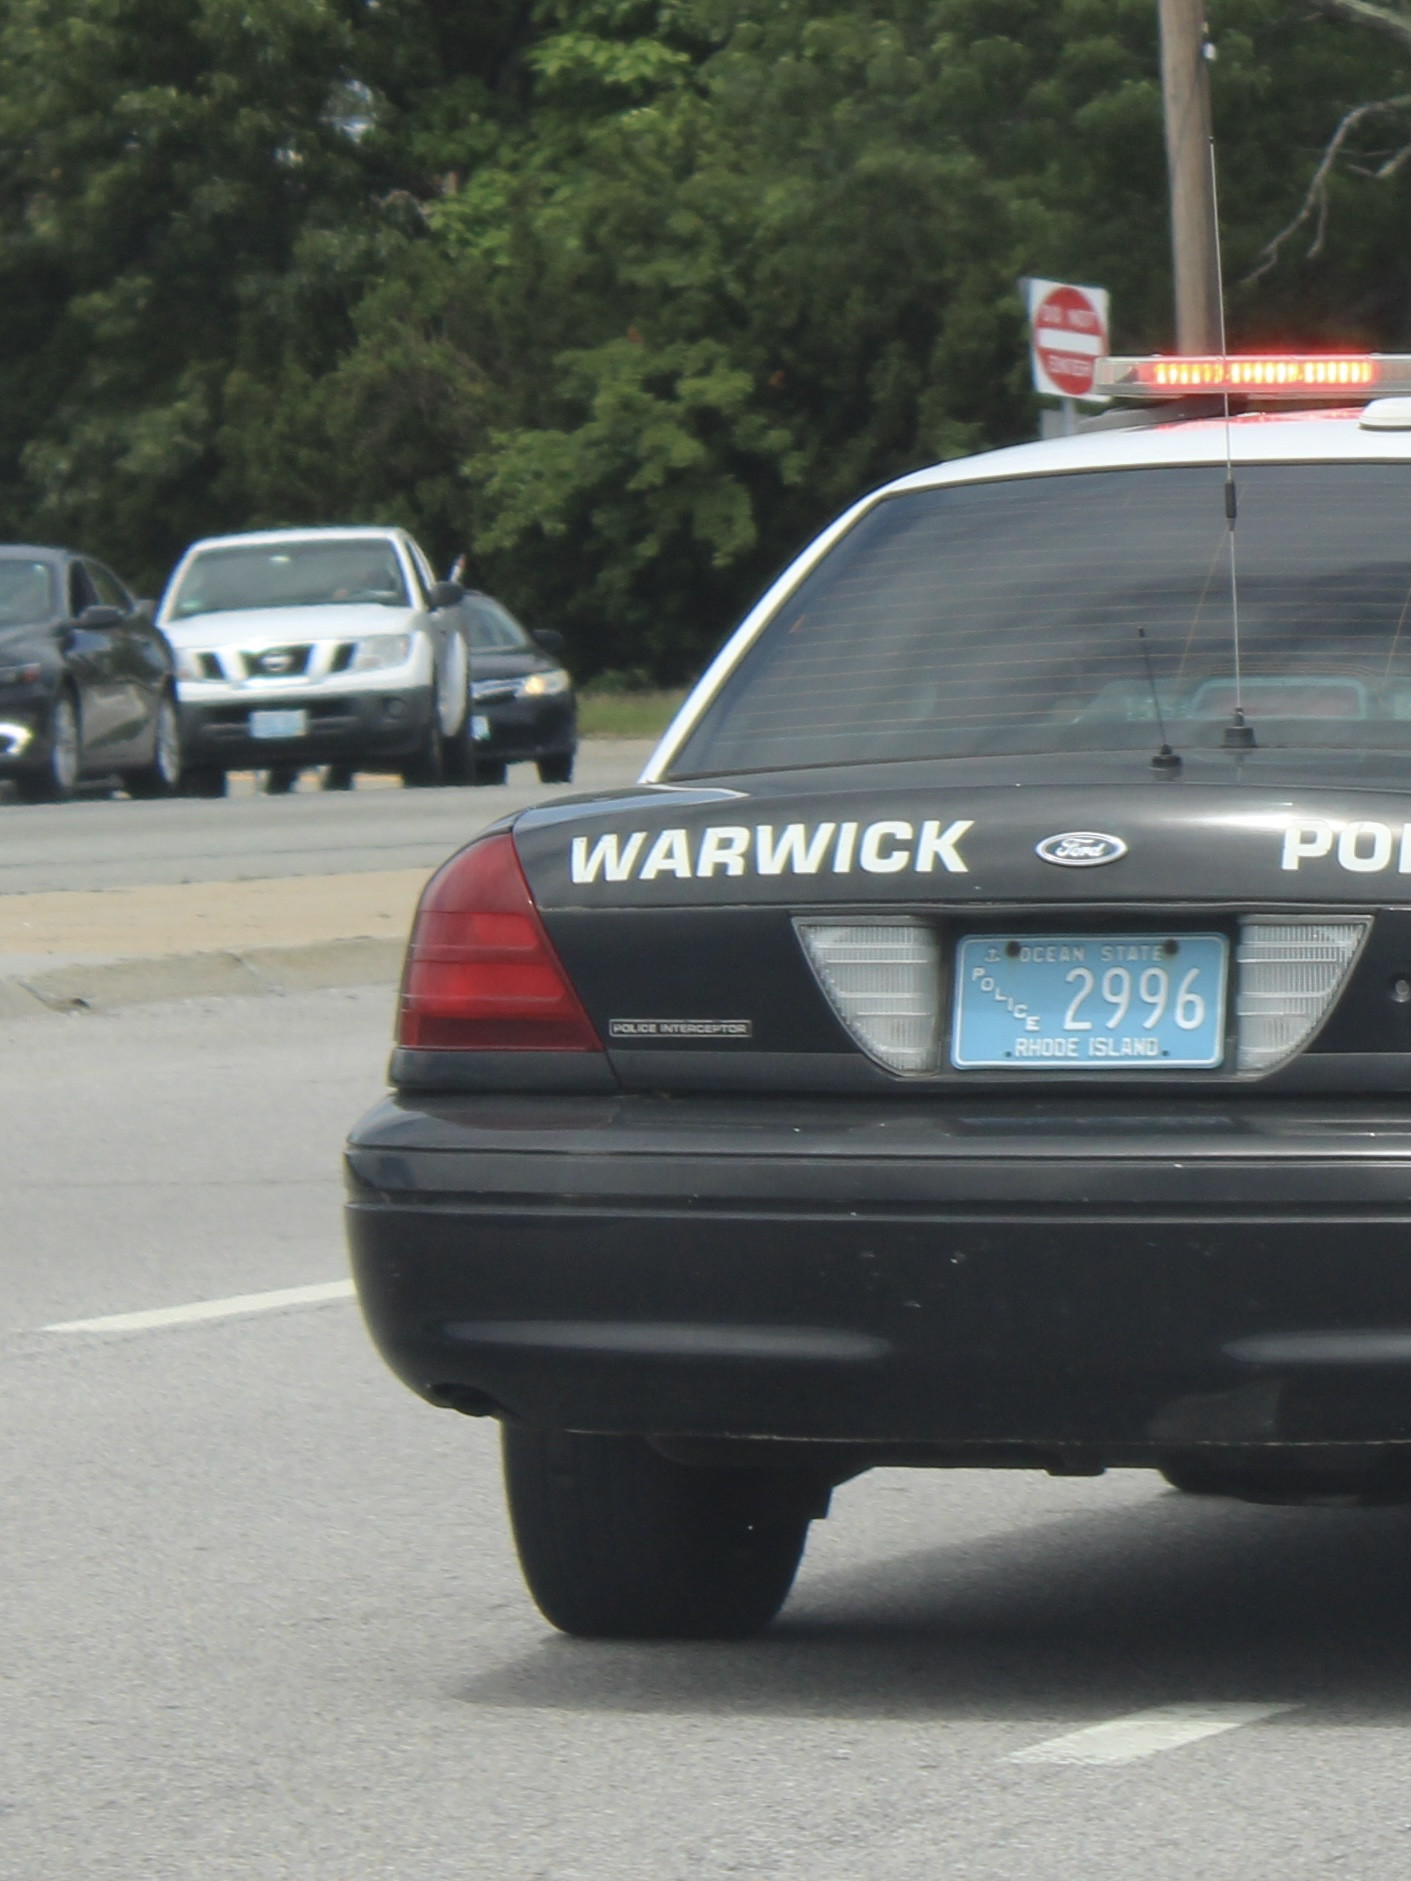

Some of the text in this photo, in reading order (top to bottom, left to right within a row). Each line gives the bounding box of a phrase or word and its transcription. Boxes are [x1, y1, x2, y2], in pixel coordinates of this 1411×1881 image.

[571, 820, 975, 884] WARWICK
[1055, 838, 1106, 857] Ford
[1020, 945, 1164, 963] OCEAN STATE
[971, 966, 1041, 1032] POLICE
[1063, 967, 1206, 1030] 2996
[613, 1023, 747, 1034] POLICE INTERCEPTOR
[1015, 1037, 1159, 1058] RHODE ISLAND
